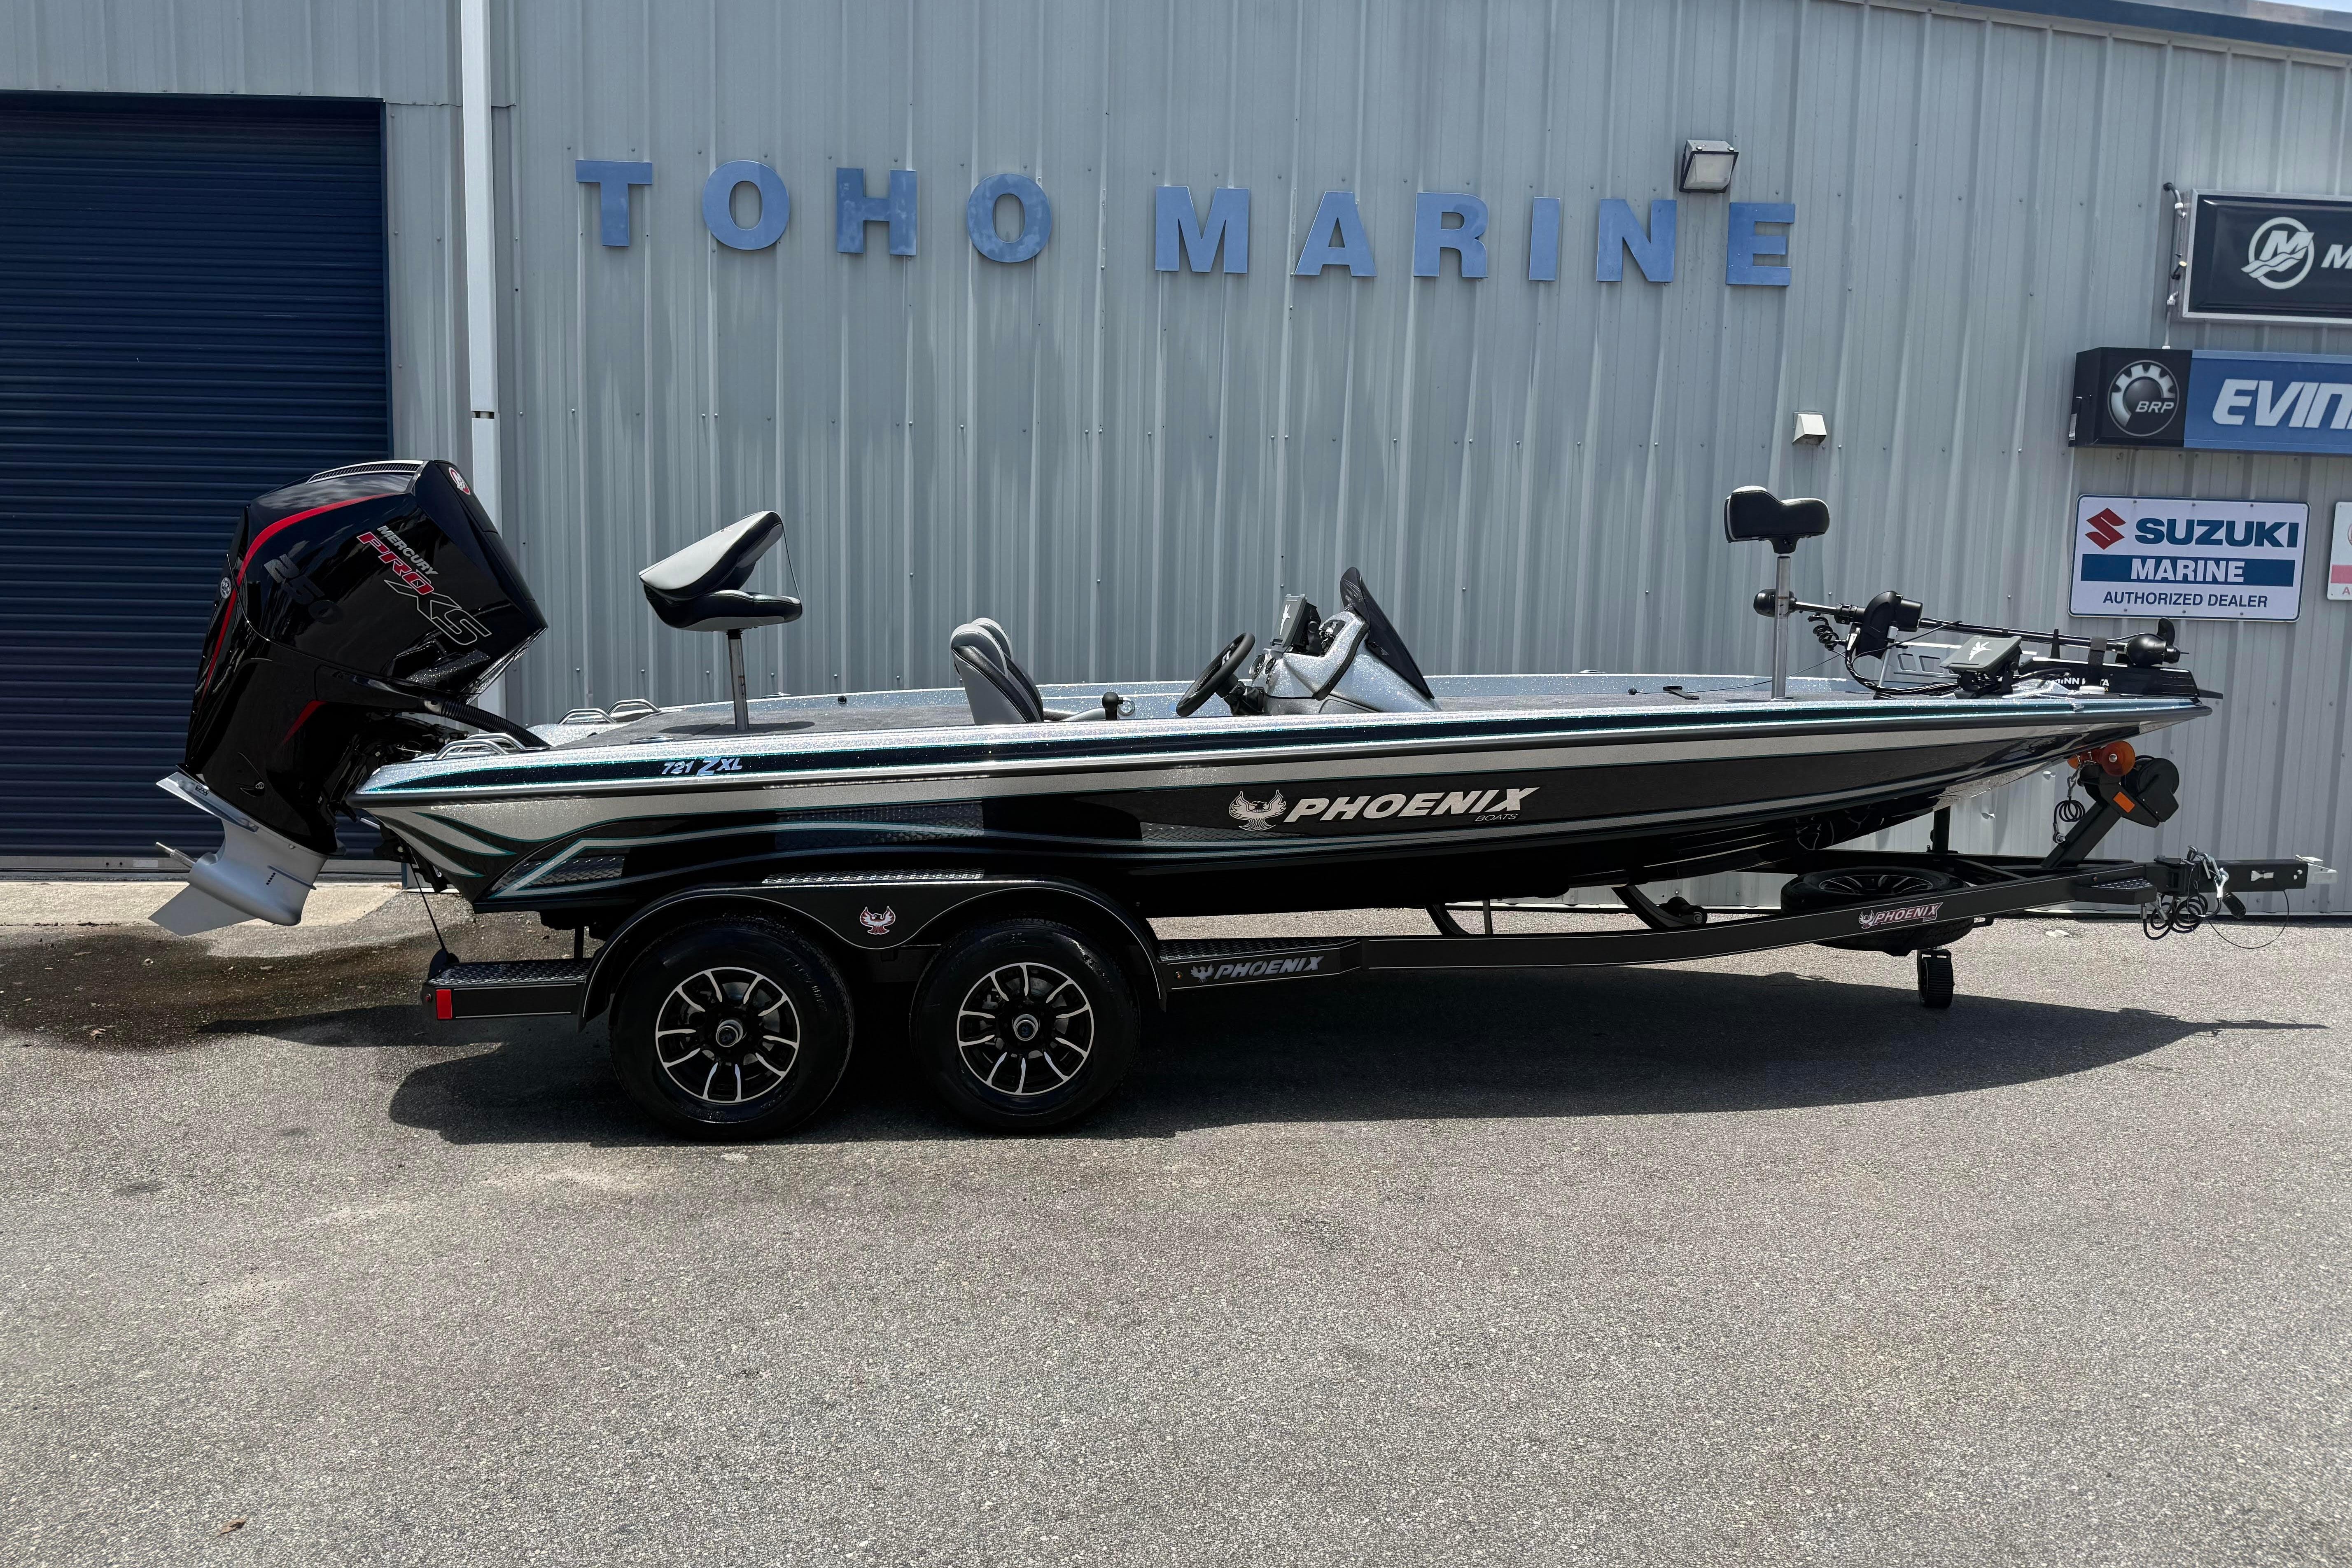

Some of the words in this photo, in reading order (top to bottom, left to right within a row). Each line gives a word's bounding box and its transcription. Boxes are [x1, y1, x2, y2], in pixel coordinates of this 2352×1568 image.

[576, 159, 1052, 263] TOHO
[1155, 186, 1796, 287] MARINE
[2135, 401, 2175, 413] BRP
[2212, 378, 2352, 429] EVIN
[2135, 518, 2299, 548] SUZUKI
[357, 531, 434, 595] PRO
[377, 525, 439, 575] MERCURY
[2130, 558, 2245, 583] MARINE
[384, 569, 492, 645] XS
[2102, 591, 2203, 606] AUTHORIZED
[2207, 595, 2268, 608] DEALER
[661, 761, 695, 775] 721
[1283, 787, 1540, 823] PHOENIX
[1475, 813, 1519, 822] BOATS
[1872, 905, 1938, 925] PHOENIX
[1213, 956, 1325, 980] PHOENIX
